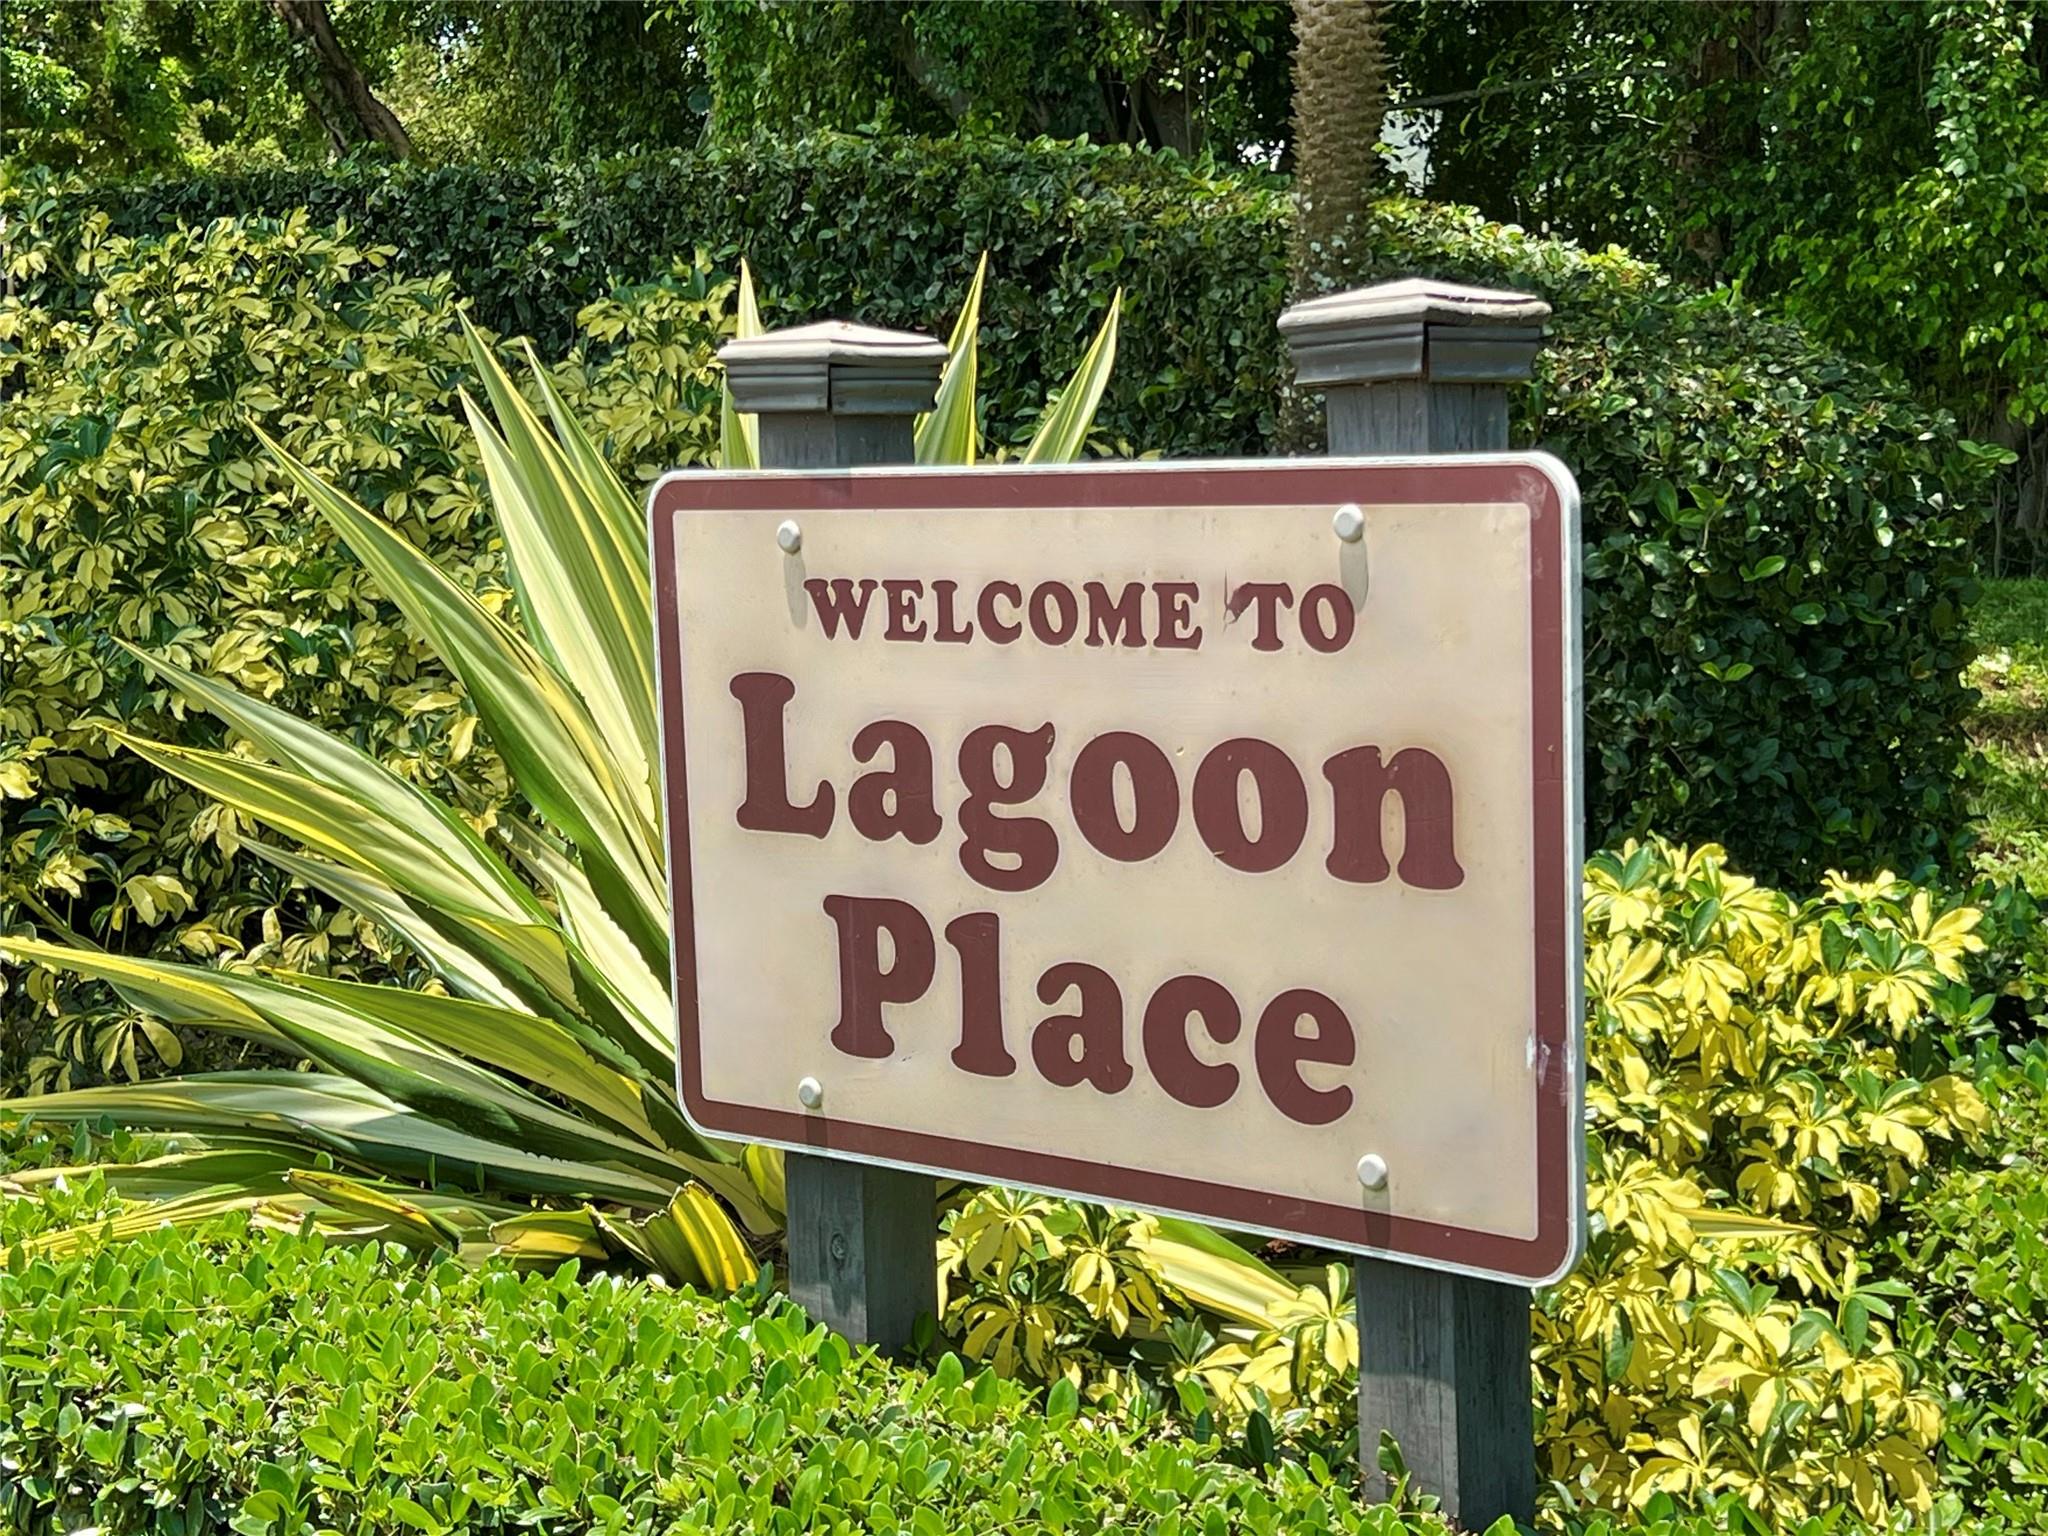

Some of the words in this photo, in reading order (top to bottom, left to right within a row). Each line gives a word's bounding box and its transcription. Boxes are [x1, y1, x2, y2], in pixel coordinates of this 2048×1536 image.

[803, 578, 1203, 650] WELCOME
[1226, 582, 1356, 654] TO
[729, 671, 1465, 892] Lagoon
[822, 894, 1357, 1126] Place
